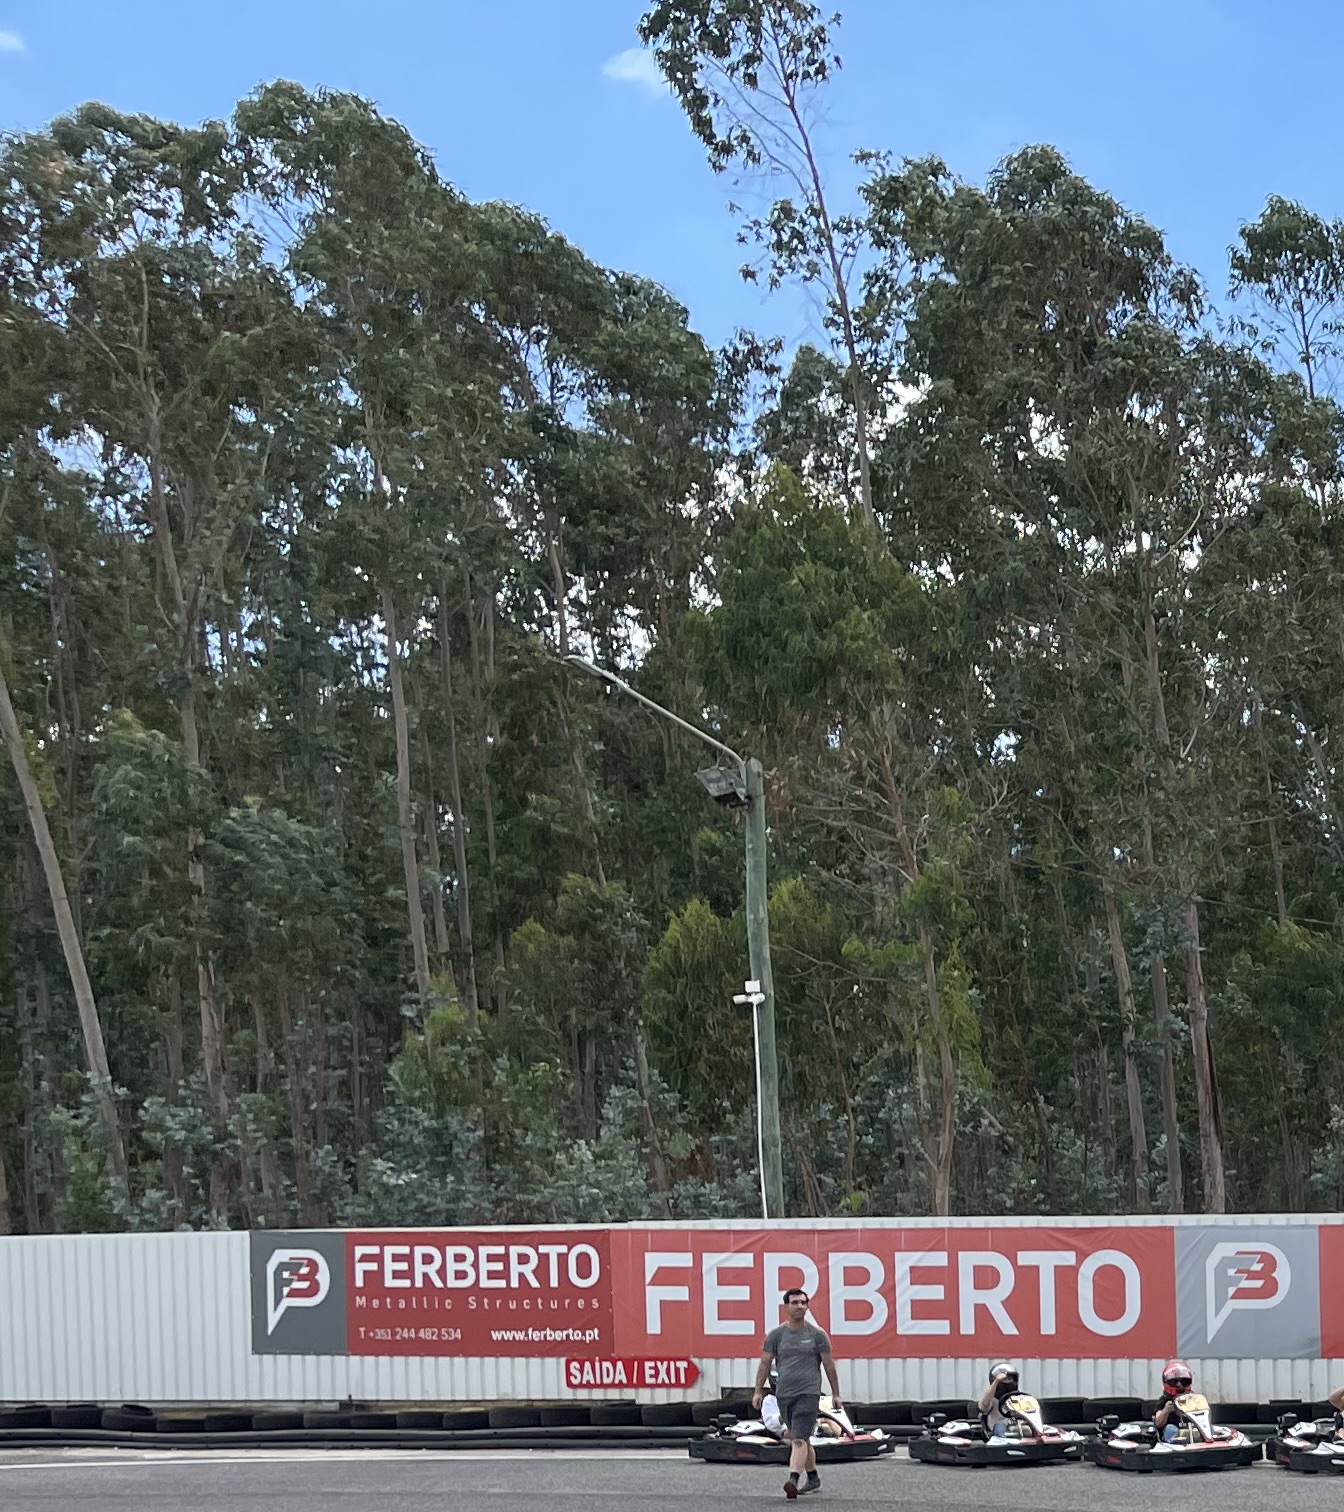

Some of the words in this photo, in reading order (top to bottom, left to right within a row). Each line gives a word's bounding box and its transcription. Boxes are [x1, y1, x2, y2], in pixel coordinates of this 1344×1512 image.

[354, 1244, 600, 1289] FERBERTO
[356, 1296, 453, 1309] Metallic
[468, 1296, 600, 1309] Structures
[645, 1249, 1141, 1337] FERBERTO
[396, 1328, 416, 1341] 244
[418, 1327, 438, 1340] 482
[441, 1327, 461, 1340] 534
[491, 1326, 600, 1343] www.ferberto.pt
[570, 1356, 627, 1386] SAÍDA
[644, 1361, 689, 1386] EXIT
